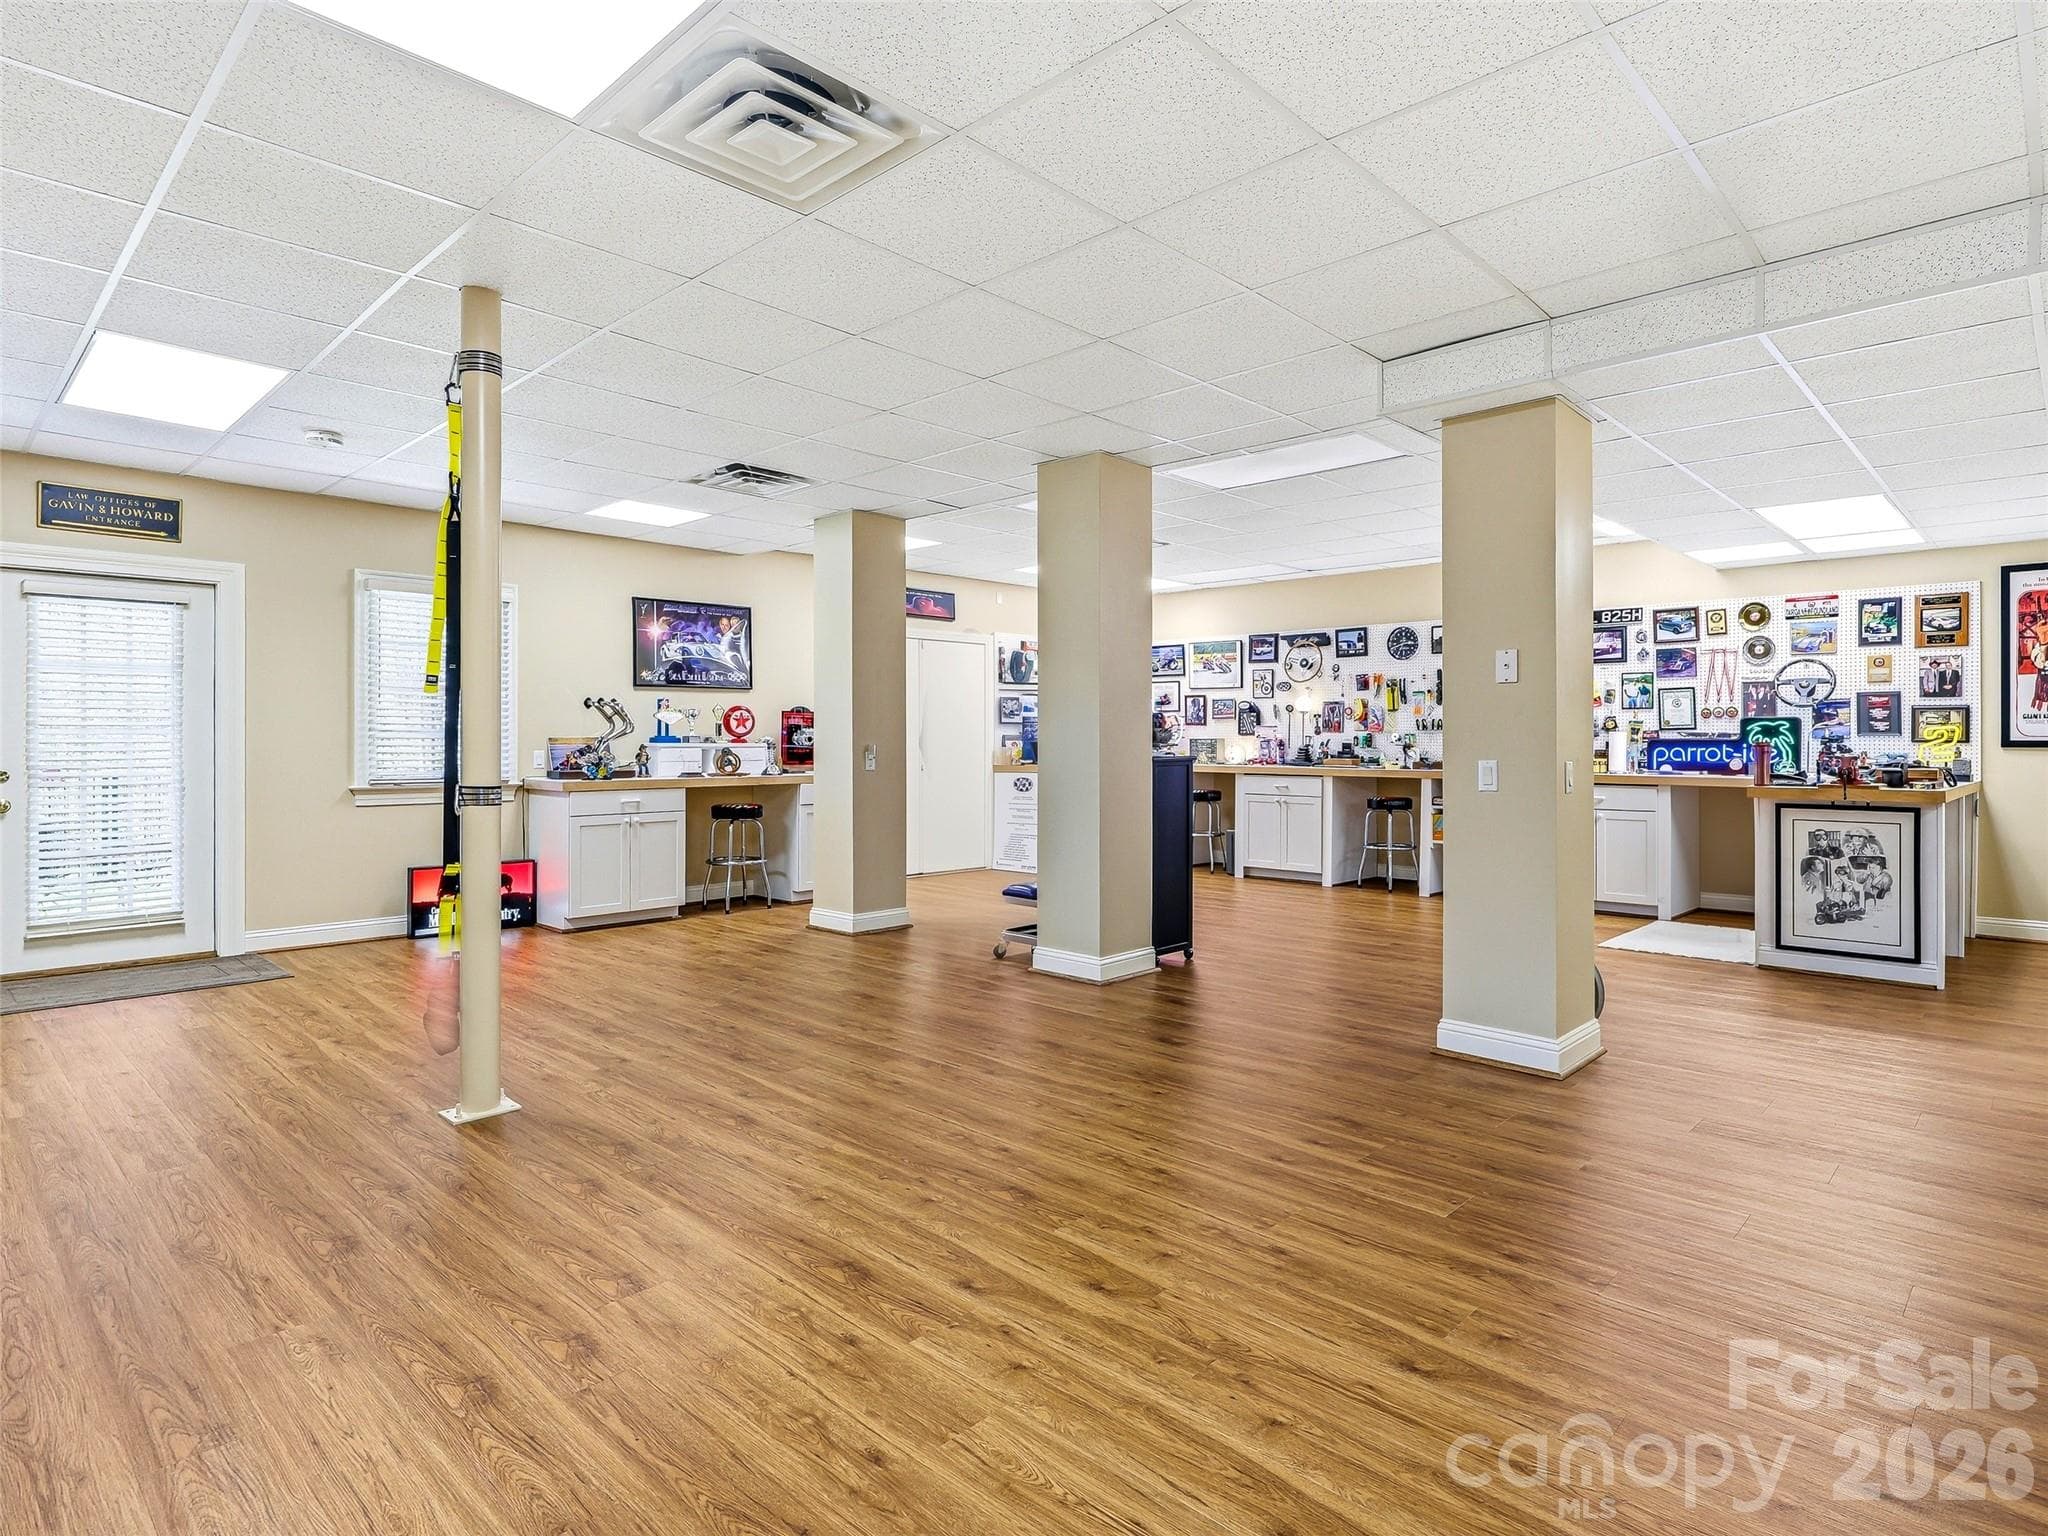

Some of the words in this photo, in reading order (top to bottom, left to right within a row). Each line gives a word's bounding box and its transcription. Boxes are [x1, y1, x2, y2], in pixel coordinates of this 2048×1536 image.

[68, 491, 89, 500] LAW
[94, 494, 140, 507] OFFICES
[144, 501, 158, 509] OF
[48, 498, 95, 513] GAVIN
[98, 505, 106, 514] &
[110, 505, 174, 522] HOWARD
[85, 514, 141, 528] ENTRANCE
[1601, 608, 1642, 623] 825H
